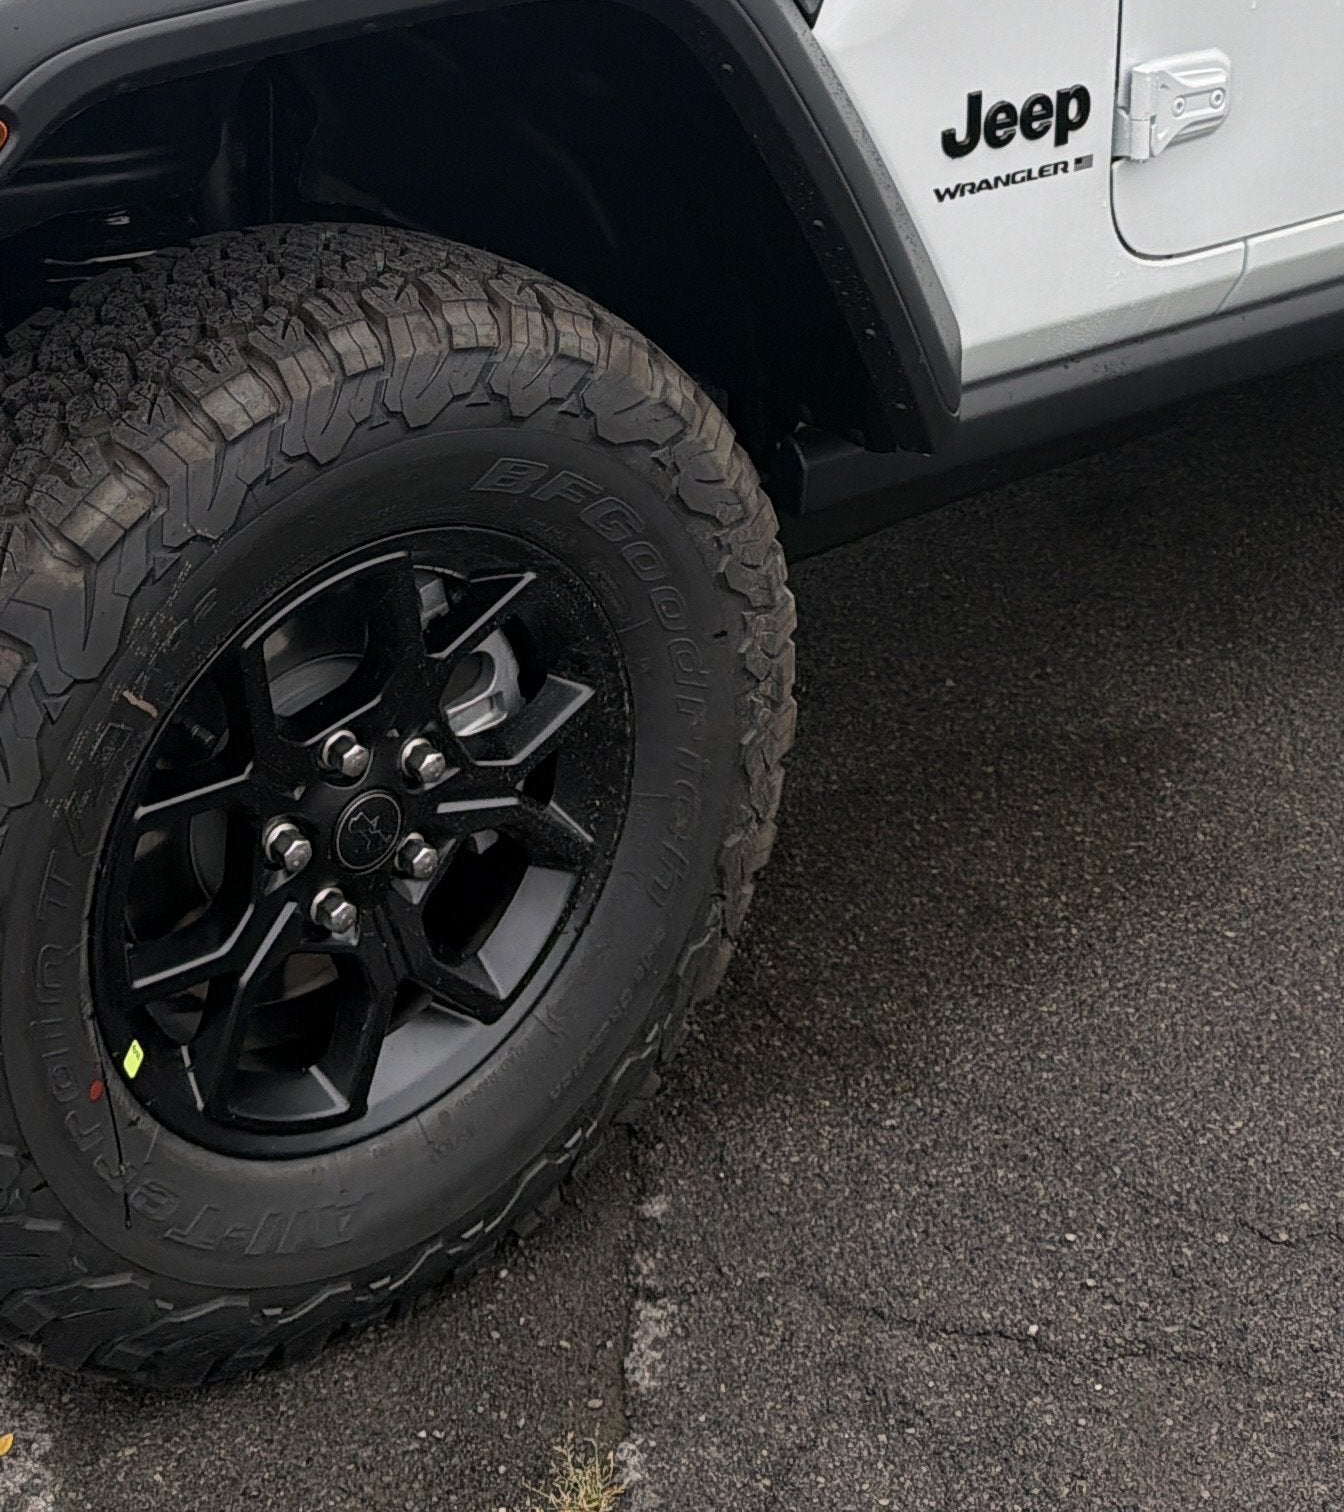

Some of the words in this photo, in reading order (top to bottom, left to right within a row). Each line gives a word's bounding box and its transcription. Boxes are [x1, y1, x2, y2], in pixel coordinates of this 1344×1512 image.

[941, 83, 1091, 160] Jeep
[932, 160, 1070, 203] WRANGLER
[469, 454, 711, 911] BFGoodrich
